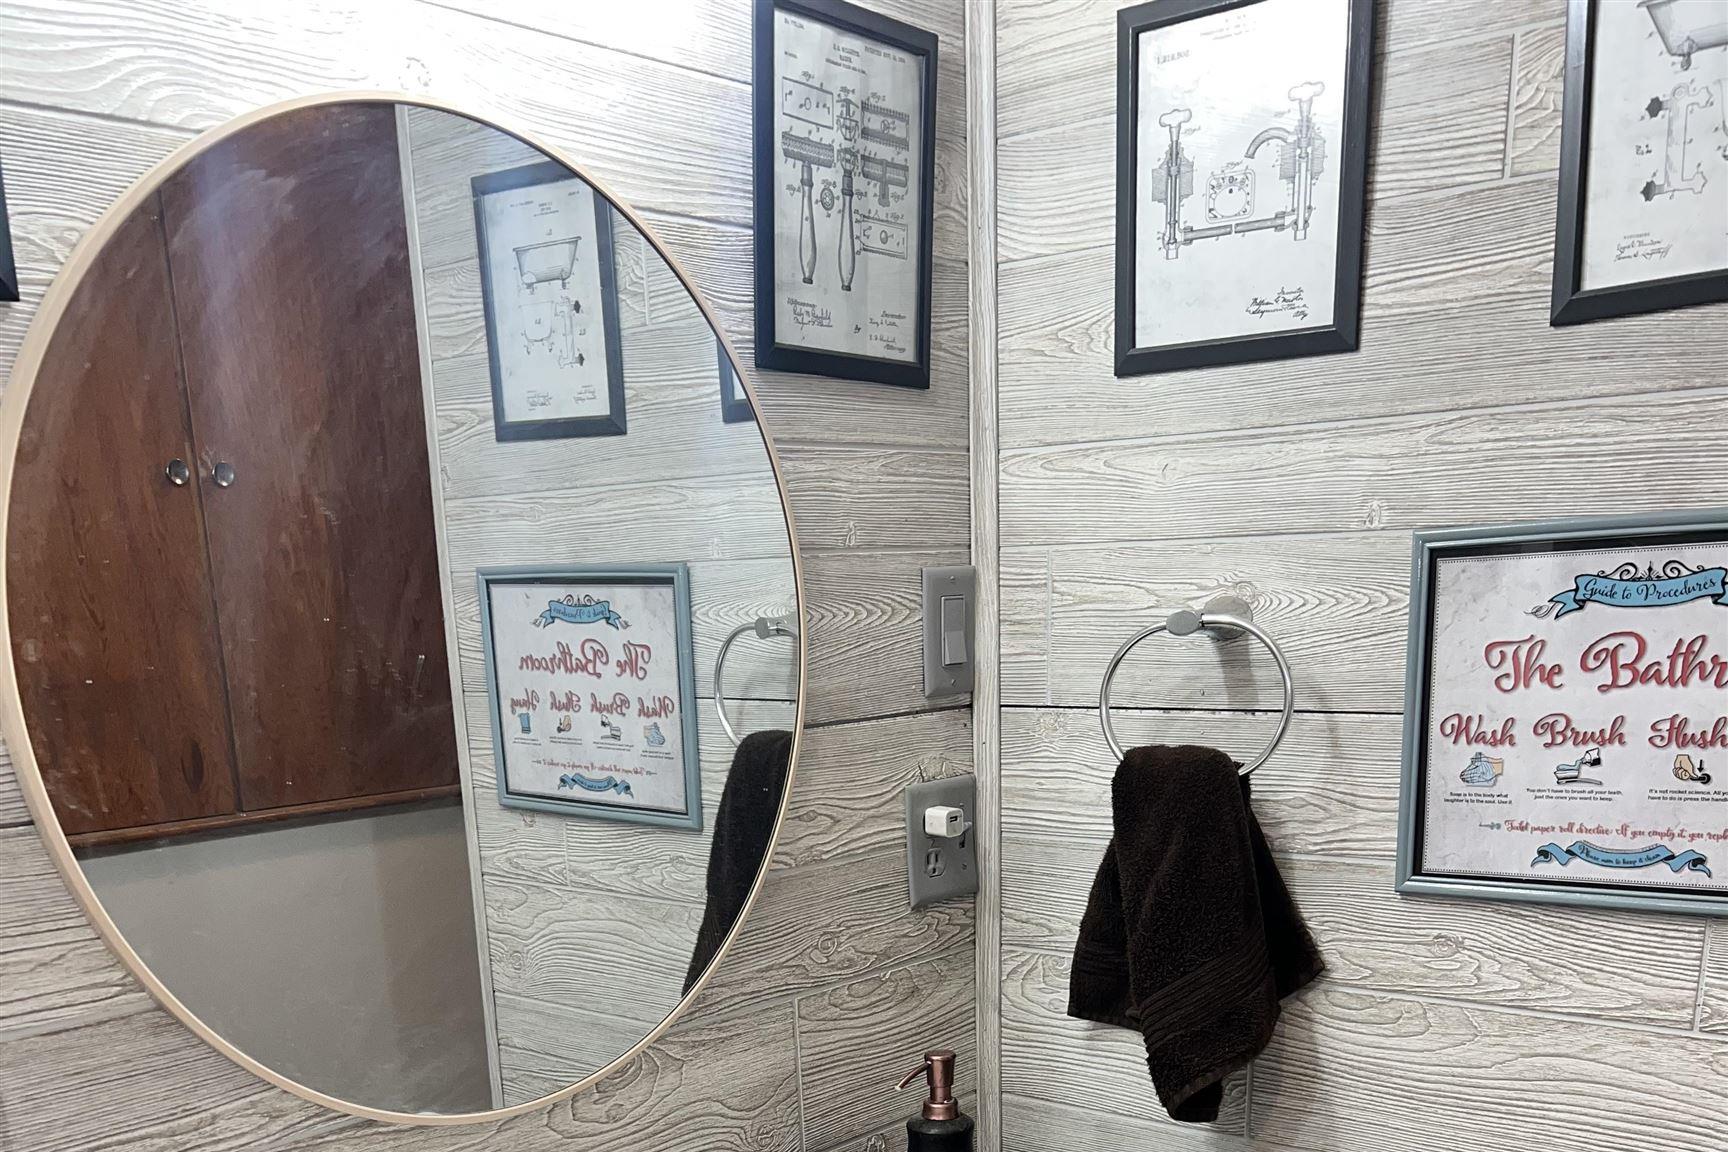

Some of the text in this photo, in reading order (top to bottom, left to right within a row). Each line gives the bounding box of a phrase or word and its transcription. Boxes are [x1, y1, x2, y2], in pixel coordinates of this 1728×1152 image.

[1583, 578, 1716, 600] Guide to Procedures
[1485, 631, 1728, 693] The Bathr
[1440, 713, 1728, 748] Wash Brush Flush
[1531, 825, 1555, 834] paper
[1559, 822, 1575, 833] roll
[1616, 823, 1630, 837] If
[1631, 830, 1645, 839] you
[1648, 827, 1675, 841] empty
[1689, 832, 1704, 842] you
